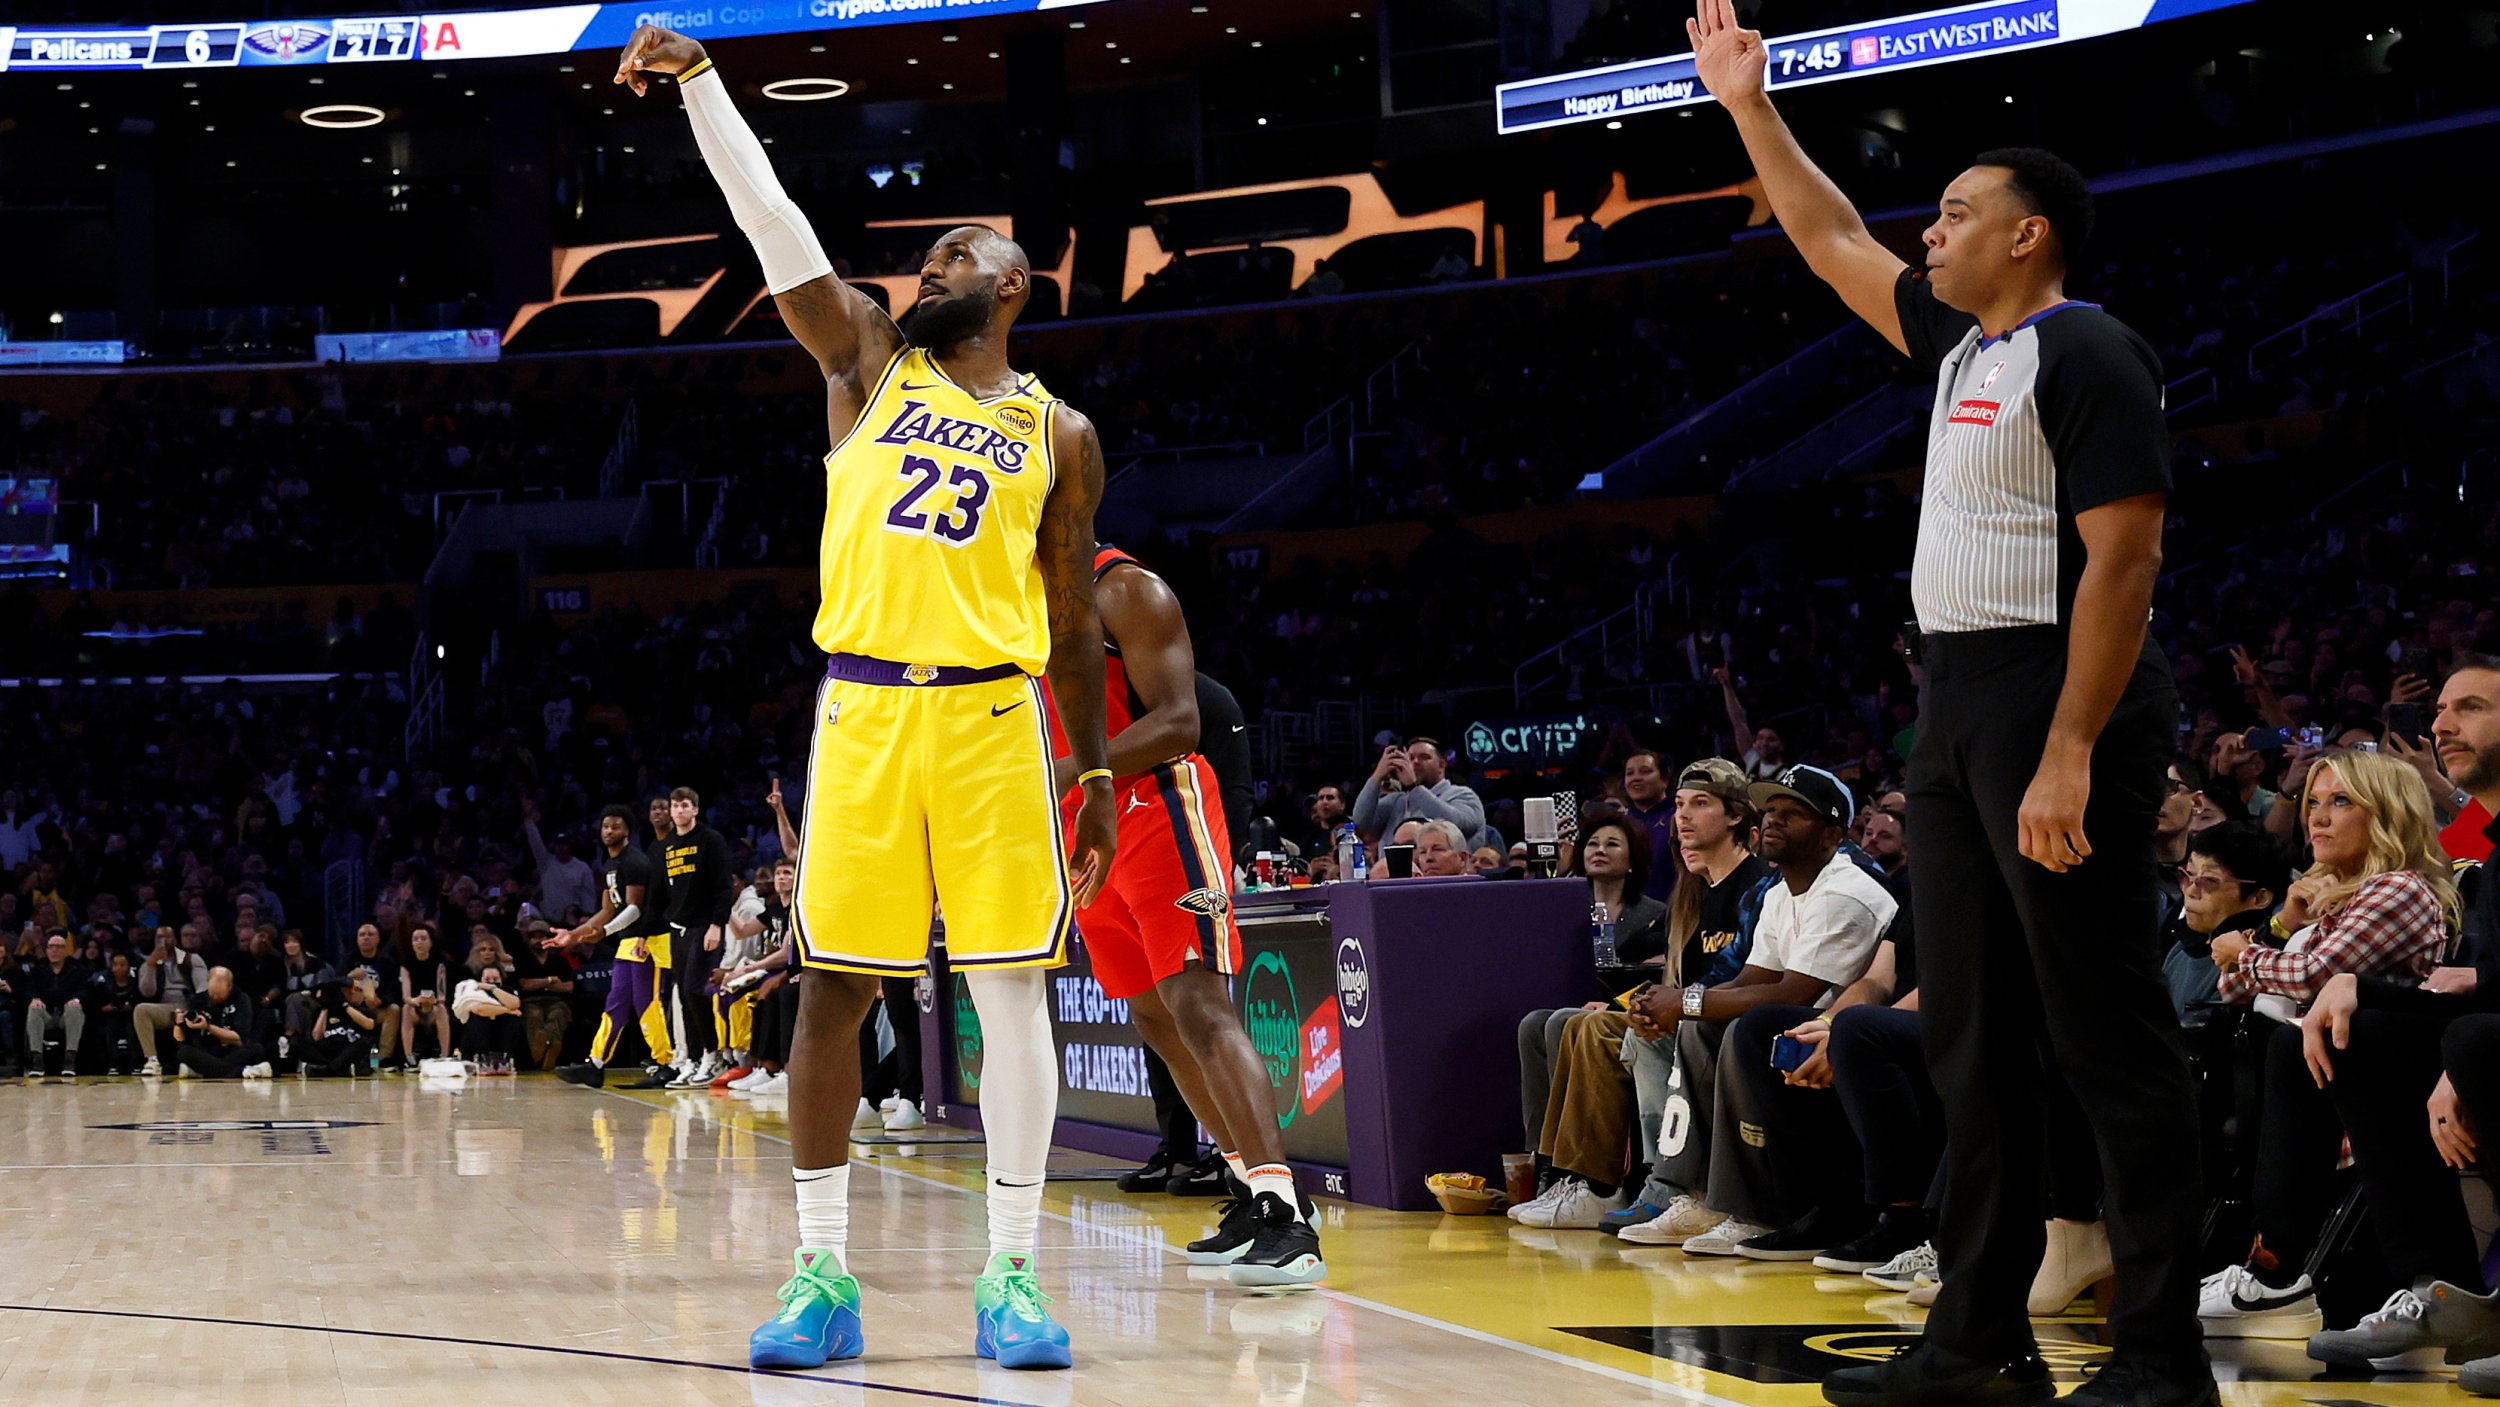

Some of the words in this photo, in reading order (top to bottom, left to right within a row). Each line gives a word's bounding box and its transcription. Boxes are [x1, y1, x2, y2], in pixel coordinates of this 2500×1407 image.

[635, 9, 713, 29] Official
[31, 38, 132, 60] Pelicans
[185, 30, 210, 65] 6
[346, 35, 364, 57] 2
[387, 34, 403, 56] 7
[1779, 42, 1842, 75] 7:45
[1564, 93, 1618, 115] Happy
[1621, 81, 1694, 106] Birthday
[999, 412, 1033, 430] bibigo
[1952, 404, 1996, 421] Emirates
[873, 400, 1031, 474] LAKERS
[883, 453, 993, 549] 23
[1340, 961, 1366, 1001] bibigo
[1055, 976, 1083, 1023] THE
[1250, 999, 1297, 1077] bibigo
[1309, 1026, 1328, 1058] Live
[1065, 1042, 1082, 1090] OF
[1083, 1043, 1138, 1096] LAKERS
[1303, 1048, 1342, 1100] Delicious
[1325, 1173, 1345, 1195] anc
